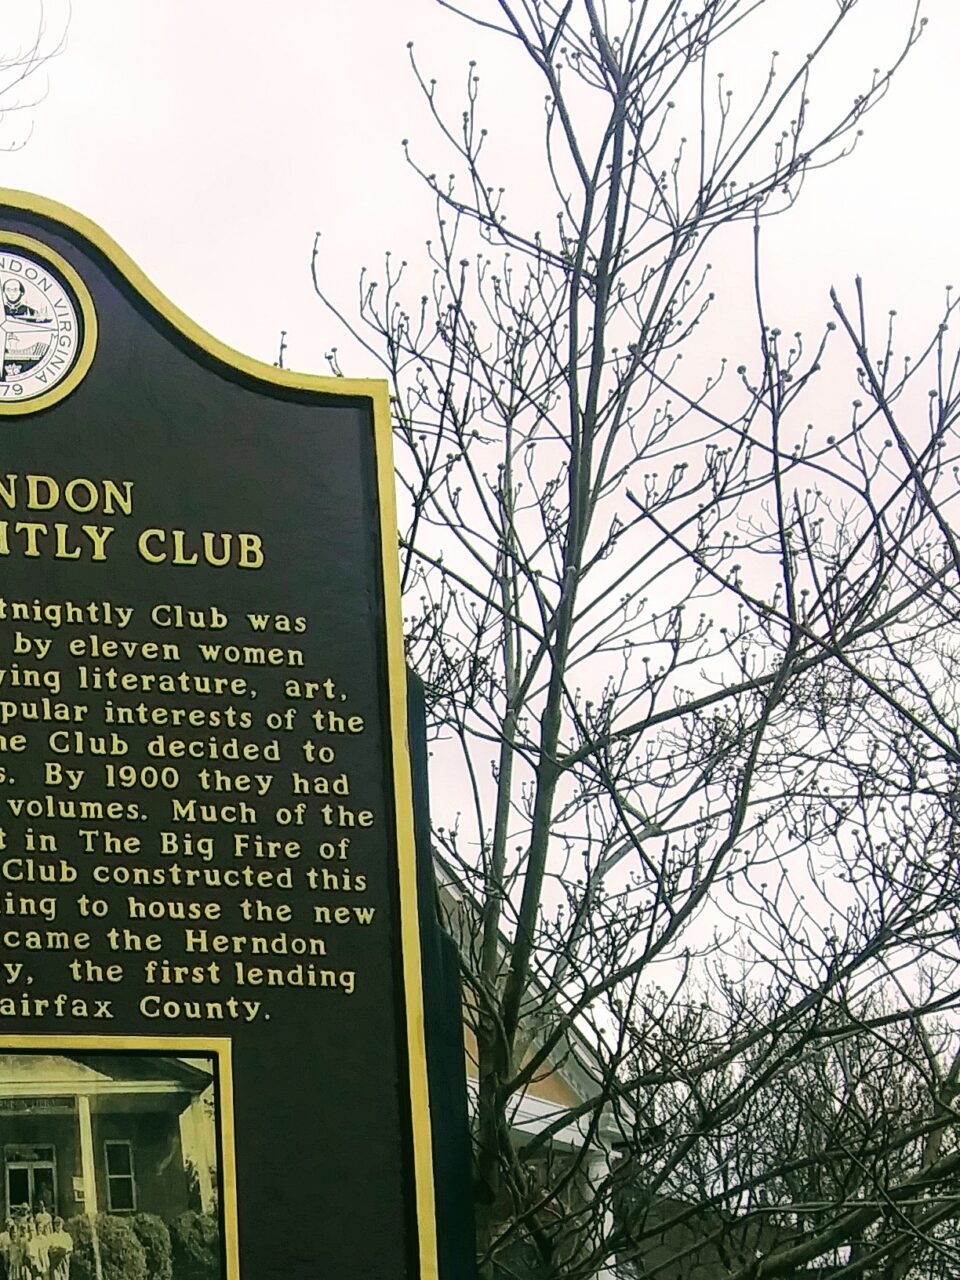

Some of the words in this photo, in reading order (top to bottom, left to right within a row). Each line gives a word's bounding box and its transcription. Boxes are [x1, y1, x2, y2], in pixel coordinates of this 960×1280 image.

[36, 298, 72, 384] VIRGINIA
[138, 528, 265, 569] CLUB
[151, 604, 228, 629] Club
[246, 613, 307, 633] was
[13, 631, 53, 660] by
[69, 634, 181, 661] eleven
[197, 644, 305, 666] women
[78, 665, 257, 699] literature,
[284, 677, 347, 702] art,
[104, 700, 252, 729] interests
[266, 708, 297, 730] of
[311, 709, 364, 733] the
[48, 730, 129, 755] Club
[147, 734, 281, 761] decided
[302, 739, 335, 763] to
[44, 762, 85, 791] By
[105, 764, 180, 789] 1900
[197, 768, 274, 796] they
[292, 772, 350, 796] had
[6, 795, 148, 821] volumes.
[171, 799, 257, 824] Much
[275, 802, 307, 825] of
[320, 803, 374, 827] the
[24, 827, 58, 852] in
[78, 829, 141, 854] The
[160, 831, 214, 862] Big
[233, 833, 301, 859] Fire
[319, 837, 351, 860] of
[2, 858, 78, 883] Club
[92, 862, 293, 889] constructed
[306, 867, 367, 892] this
[76, 894, 109, 917] to
[127, 896, 221, 920] house
[239, 898, 292, 922] the
[313, 906, 376, 925] new
[106, 927, 162, 951] the
[185, 928, 327, 956] Herndon
[68, 958, 123, 982] the
[144, 959, 221, 984] first
[234, 961, 356, 994] lending
[139, 995, 270, 1022] County.
